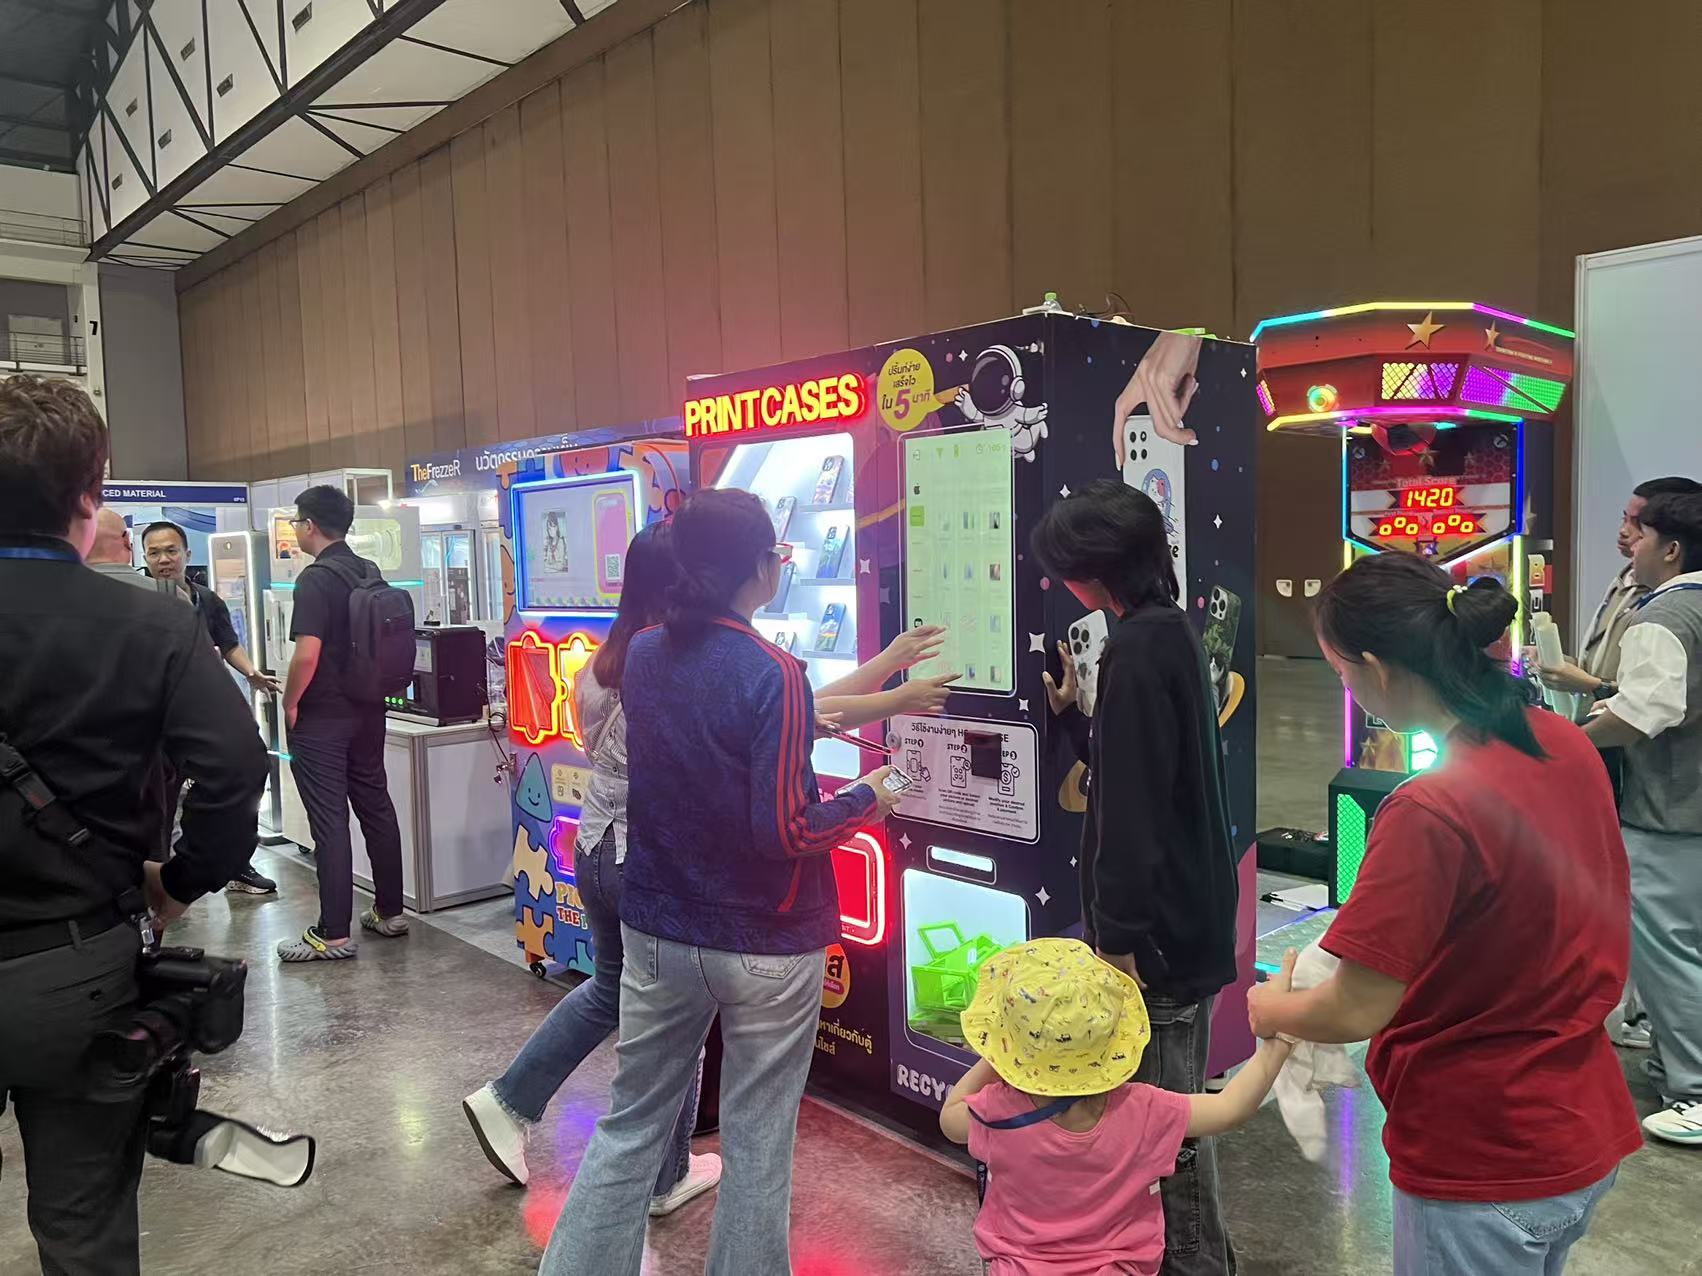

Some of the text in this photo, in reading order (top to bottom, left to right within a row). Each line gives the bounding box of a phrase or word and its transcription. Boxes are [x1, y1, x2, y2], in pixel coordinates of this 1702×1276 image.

[89, 320, 98, 336] 7
[894, 388, 912, 420] 5
[1423, 476, 1457, 486] Score
[102, 489, 167, 498] CED MATERIAL
[1406, 487, 1454, 507] 1420
[556, 905, 581, 927] THE
[819, 1017, 873, 1055] หาเกี่ยวกับตู้
[896, 1063, 953, 1102] RECY
